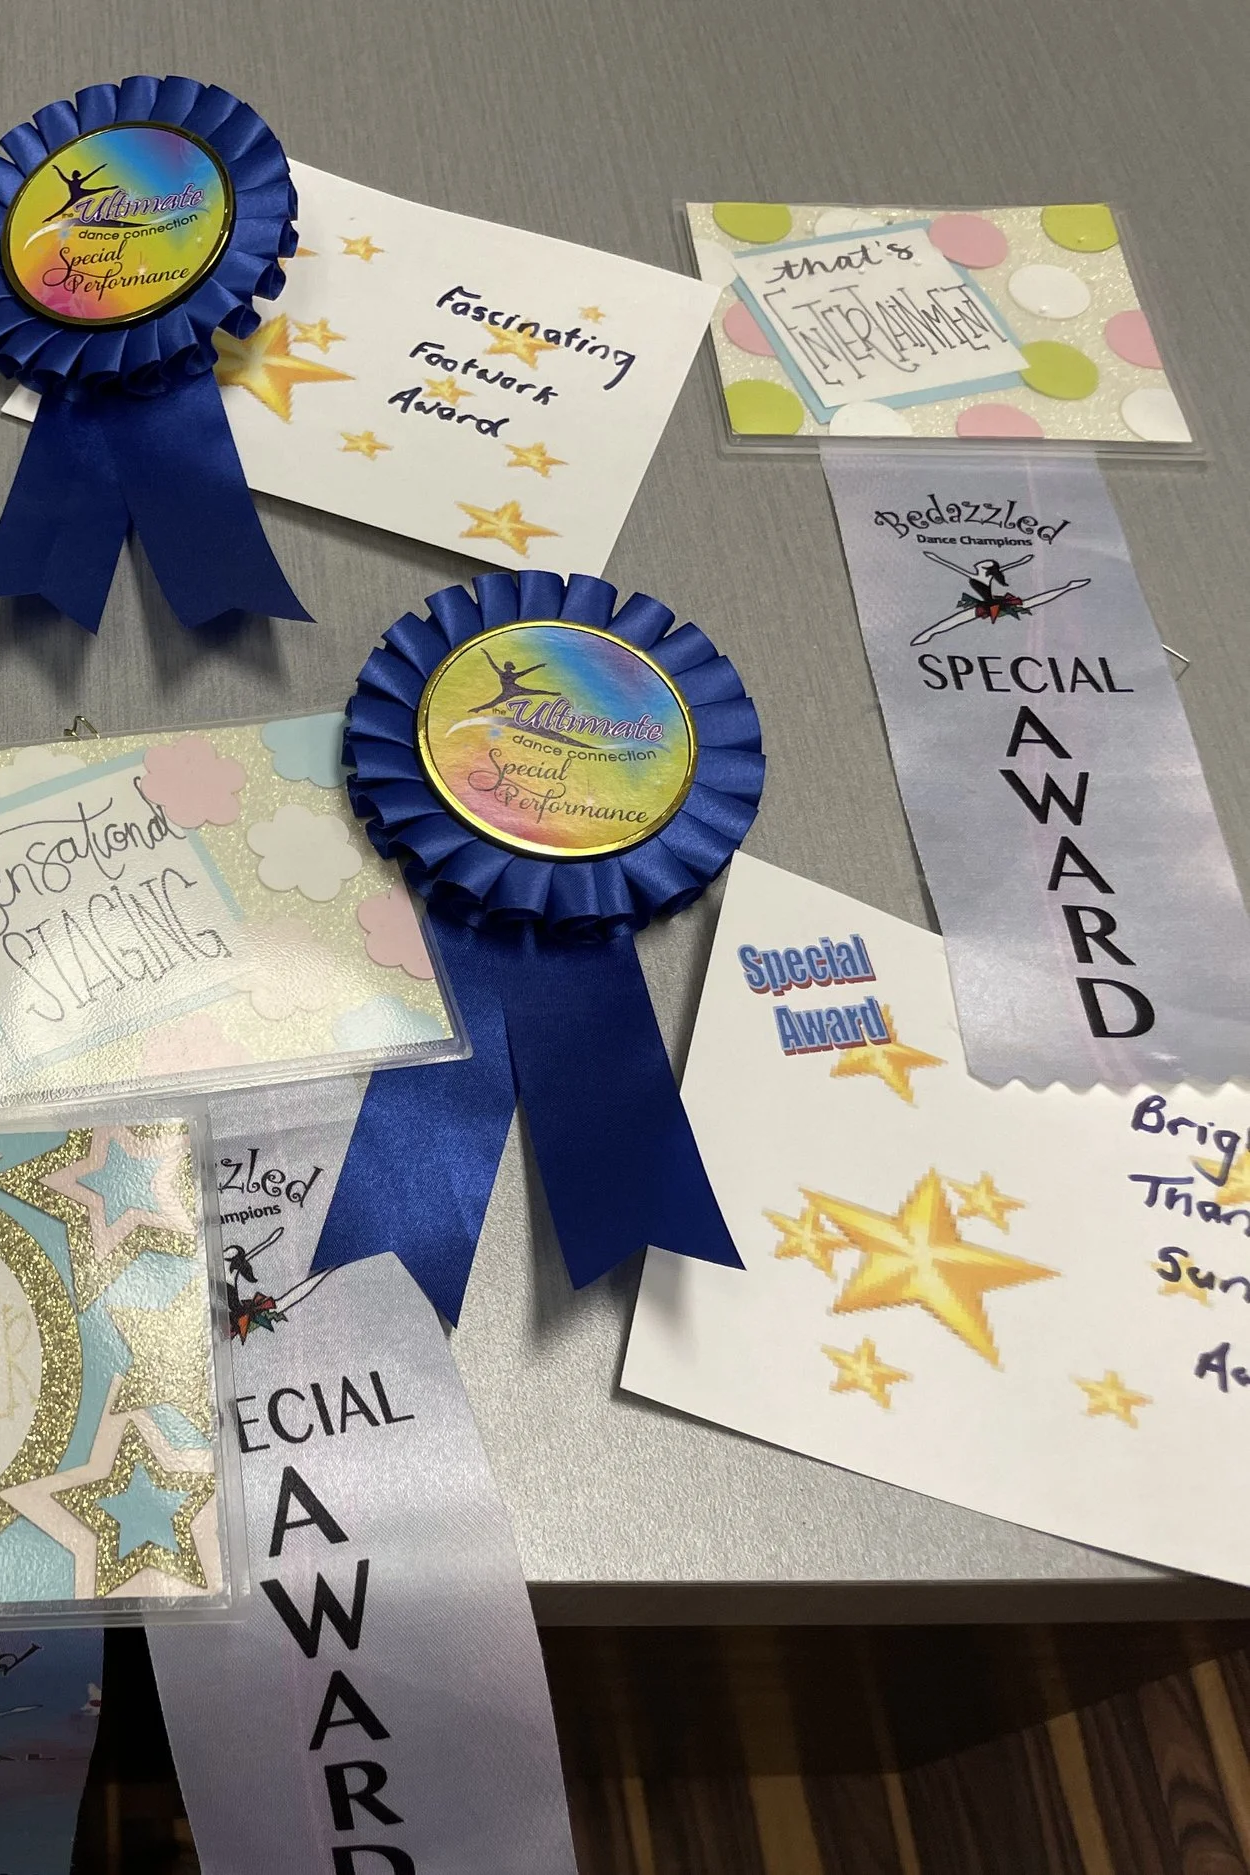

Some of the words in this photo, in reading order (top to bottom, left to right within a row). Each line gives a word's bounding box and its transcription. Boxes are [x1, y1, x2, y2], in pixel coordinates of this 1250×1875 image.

[74, 183, 205, 223] Ultimate
[78, 229, 120, 241] dance
[123, 213, 198, 240] connection
[42, 240, 128, 287] Special
[63, 268, 190, 301] Performance
[765, 241, 914, 284] that's
[436, 286, 636, 390] Fascinating
[763, 283, 1008, 386] ENTERTAINMENT
[409, 342, 558, 405] Footwork
[388, 387, 510, 437] Award
[874, 494, 1071, 544] Bedazzled
[917, 534, 956, 544] Dance
[960, 535, 1032, 547] Champions
[917, 654, 1134, 693] SPECIAL
[507, 698, 664, 742] Ultimate
[467, 748, 572, 798] Special
[512, 734, 562, 756] dance
[567, 750, 656, 763] connection
[494, 783, 648, 824] Performance
[998, 705, 1156, 1038] AWARD
[2, 867, 233, 1022] STAGING
[737, 933, 876, 996] Special
[773, 996, 891, 1056] Award
[1131, 1095, 1250, 1187] Brig
[220, 1204, 281, 1225] mpions
[236, 1370, 414, 1453] ECIAL
